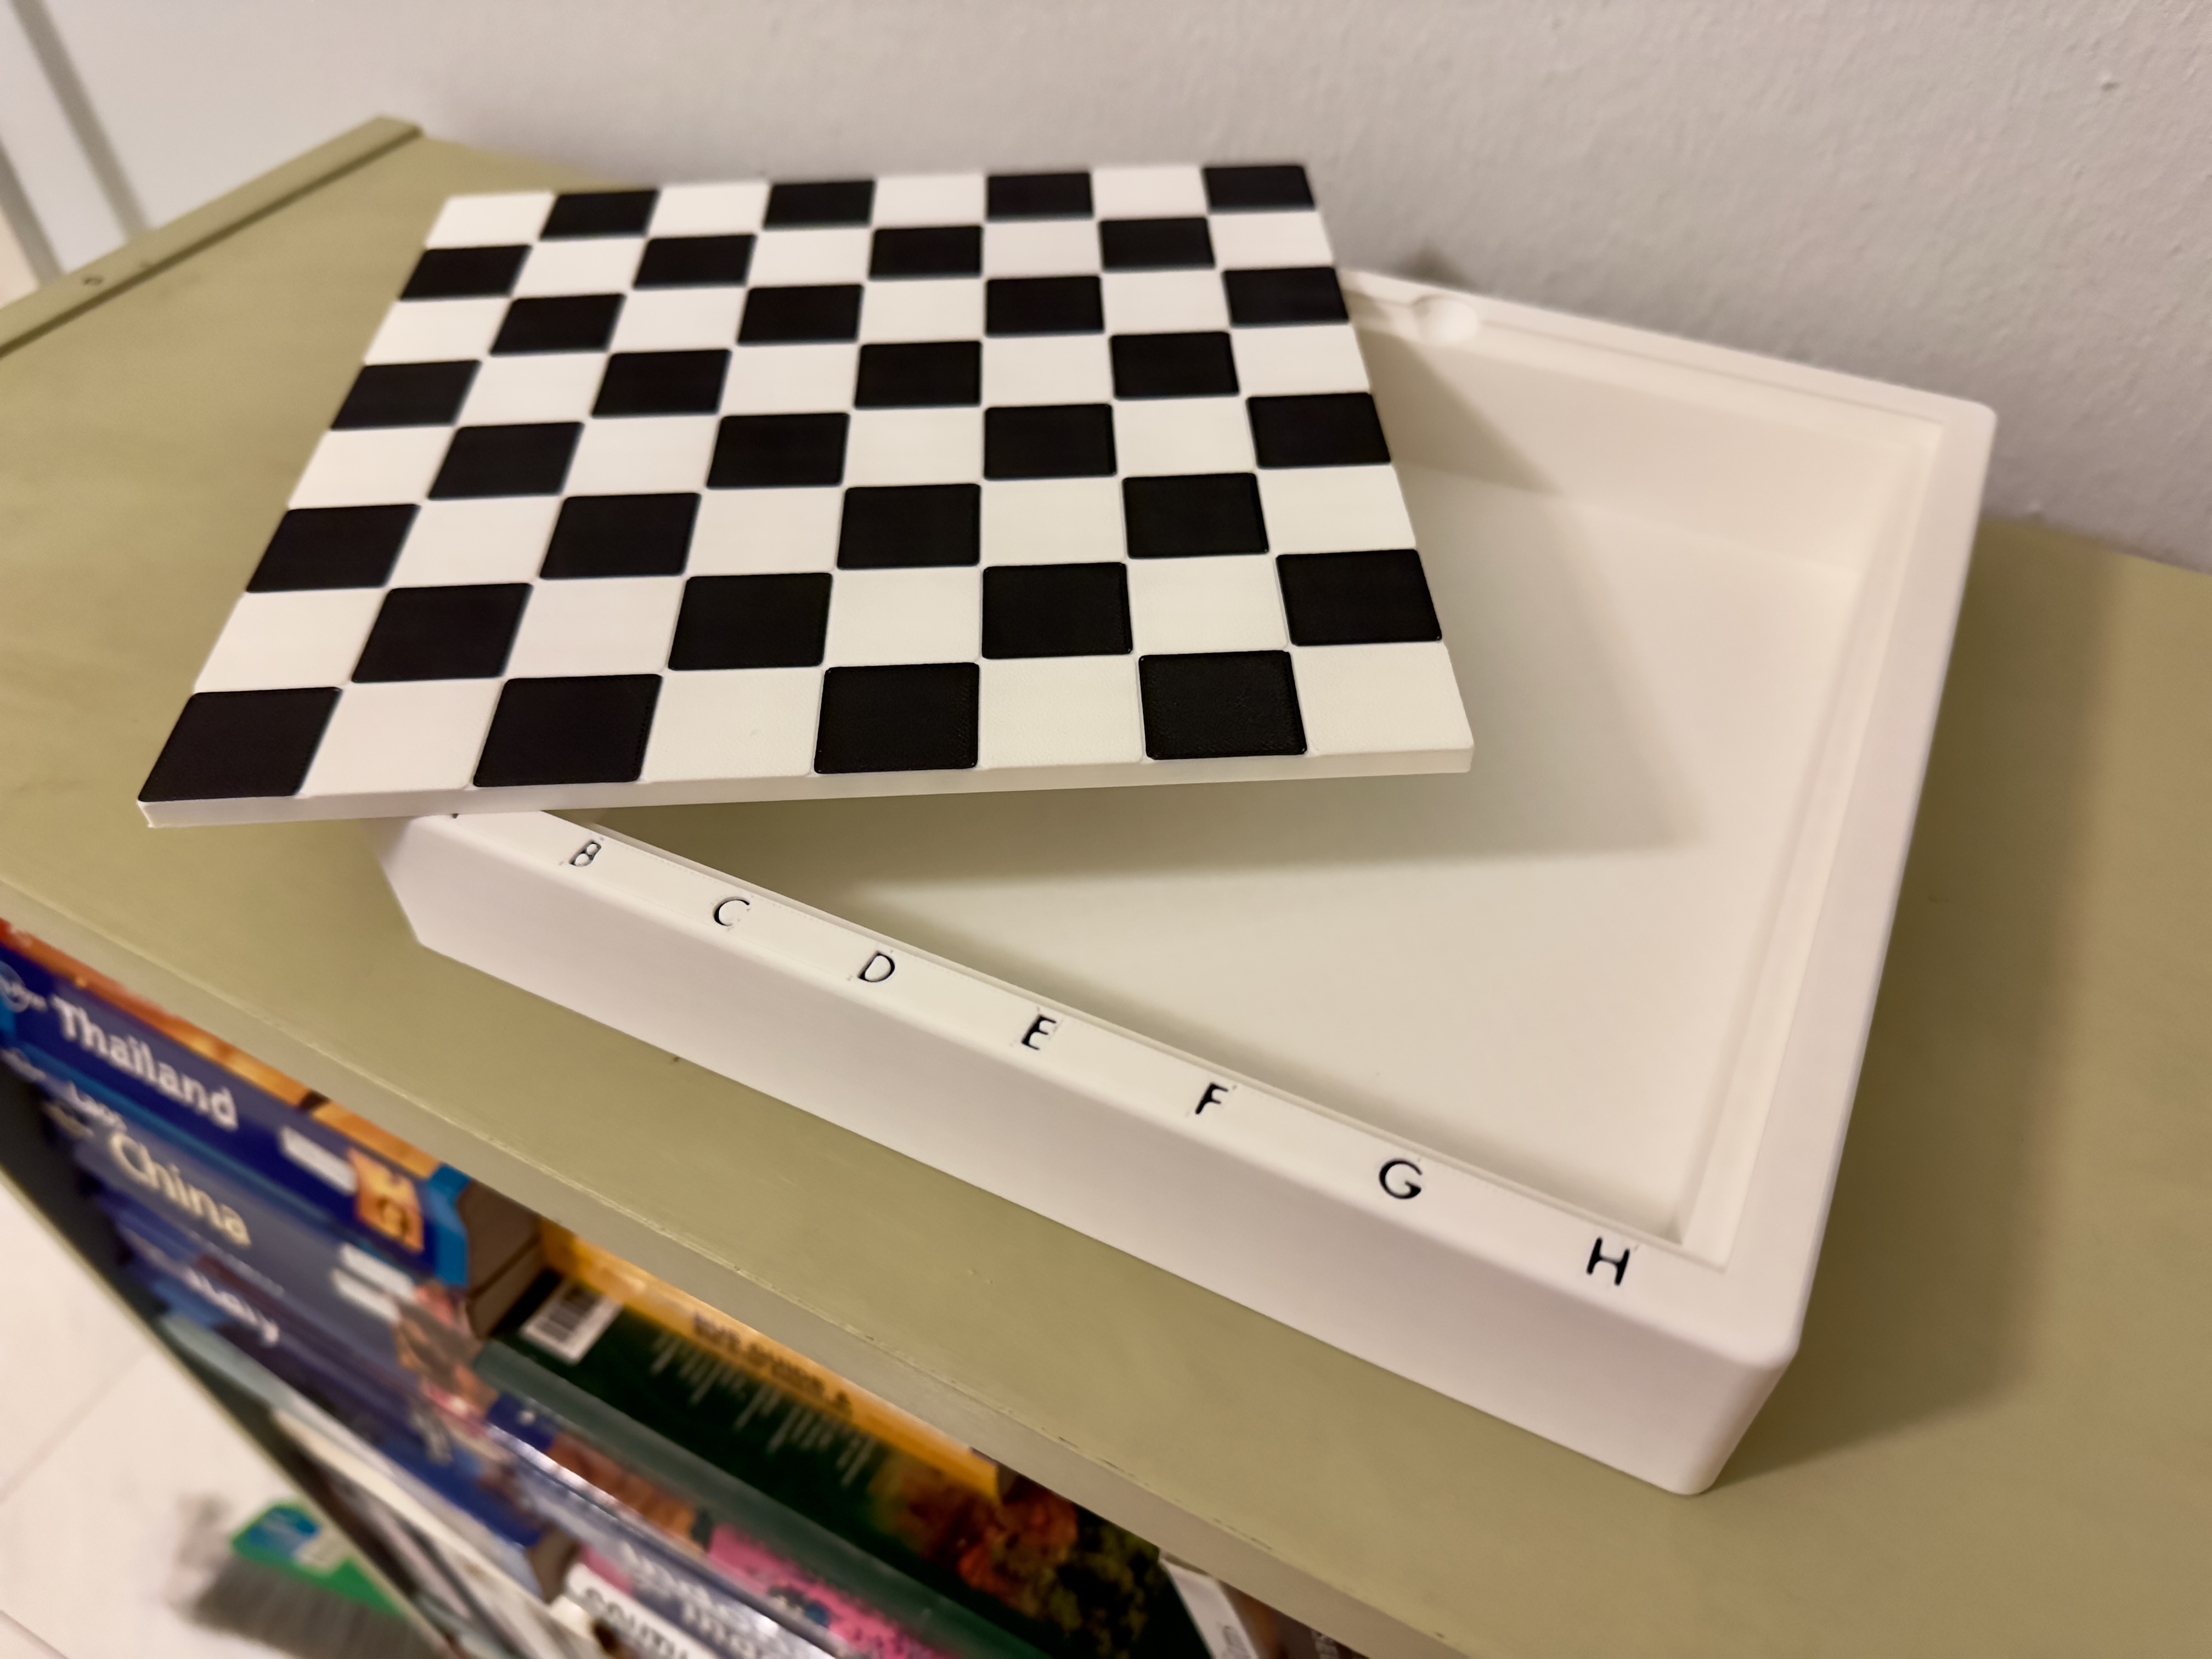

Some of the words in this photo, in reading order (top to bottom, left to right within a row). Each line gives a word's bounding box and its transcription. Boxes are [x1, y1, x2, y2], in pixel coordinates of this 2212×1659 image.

[51, 994, 238, 1132] Thailand
[569, 839, 602, 867] B
[713, 896, 751, 927] C
[857, 950, 896, 983] D
[1020, 1013, 1057, 1051] E
[1194, 1082, 1229, 1115] F
[1378, 1158, 1423, 1200] G
[1585, 1236, 1630, 1286] H
[110, 1131, 252, 1248] China
